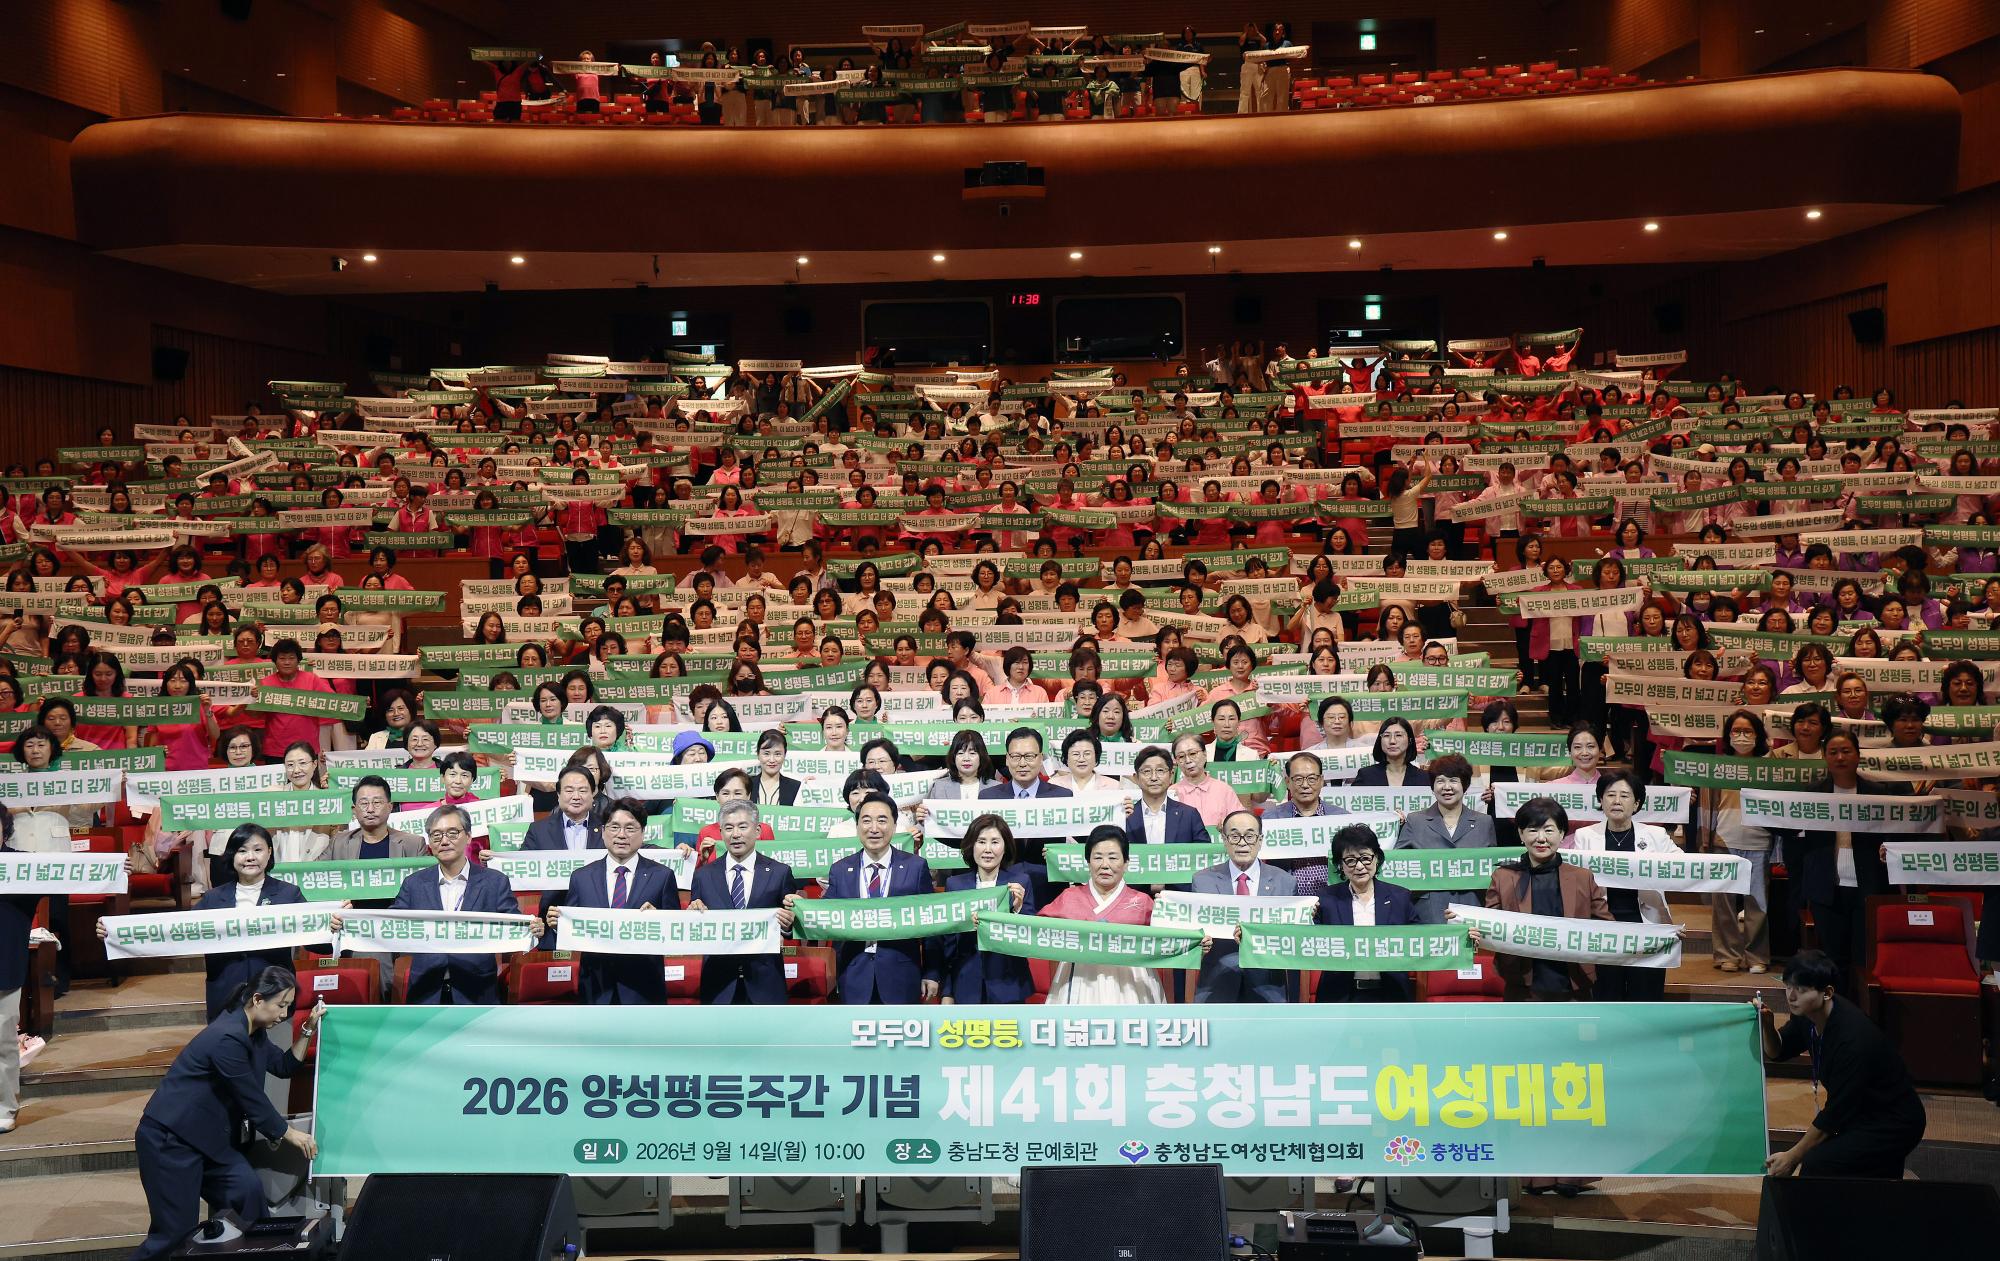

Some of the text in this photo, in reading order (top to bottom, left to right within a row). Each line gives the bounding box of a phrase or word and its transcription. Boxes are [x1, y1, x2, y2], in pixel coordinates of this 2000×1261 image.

[1011, 294, 1040, 306] 11:38
[1352, 696, 1458, 712] 성평등, 더 넓고 더 깊게
[1433, 739, 1561, 757] 모두의 성평등, 더 넓고 더
[1675, 760, 1709, 778] 모두의
[1714, 764, 1752, 782] 성평등,
[1757, 767, 1768, 781] 더
[1773, 767, 1795, 782] 넓고
[1801, 768, 1812, 782] 더
[27, 778, 111, 796] 더 넓고 더 깊게
[138, 774, 272, 795] 모두의 성평등, 더 넓고 더
[173, 798, 342, 819] 모두의 성평등, 더 넓고 더 깊게
[936, 810, 973, 826] 모두의
[1026, 809, 1037, 826] 더
[1043, 809, 1067, 826] 넓고
[1072, 808, 1084, 824] 더
[1090, 806, 1114, 823] 깊게
[1746, 799, 1937, 822] 모두의 성평등, 더 넓고 더 깊게
[17, 864, 30, 880] 더
[36, 864, 65, 880] 넓고
[70, 864, 84, 881] 더
[90, 864, 118, 881] 깊게
[1382, 859, 1492, 878] 성평등, 더 넓고 더
[1588, 853, 1738, 880] 성평등, 더 넓고 더 깊게
[804, 911, 845, 928] 모두의
[850, 909, 896, 928] 성평등,
[901, 907, 915, 926] 더
[920, 905, 946, 924] 넓고
[952, 902, 965, 921] 더
[1154, 901, 1192, 923] 모두의
[1250, 907, 1264, 924] 더
[1269, 908, 1296, 924] 넓고
[117, 926, 165, 944] 모두의
[170, 922, 222, 942] 성평등,
[226, 920, 241, 937] 더
[246, 918, 276, 936] 넓고
[282, 916, 296, 933] 더
[343, 920, 375, 938] 두의
[381, 920, 430, 941] 성평등,
[435, 921, 449, 939] 더
[455, 920, 484, 939] 넓고
[490, 920, 504, 938] 더
[572, 919, 768, 942] 모두의 성평등, 더 넓고 더 깊게
[990, 924, 1031, 944] 모두의
[1037, 928, 1084, 952] 성평등,
[1089, 933, 1102, 952] 더
[1108, 935, 1136, 954] 넓고
[1142, 937, 1155, 955] 더
[1513, 925, 1561, 949] 성평등,
[1568, 931, 1582, 951] 더
[1588, 932, 1617, 953] 넓고
[1624, 936, 1636, 954] 더
[1642, 937, 1674, 955] 깊게
[1252, 936, 1458, 959] 모두의 성평등, 더 넓고 더 깊게
[851, 1018, 1208, 1048] 모두의 성평등, 더 넓고 더 깊게
[463, 1075, 921, 1119] 2026 양성평등주간 기념
[938, 1064, 1127, 1127] 제41회
[636, 1141, 697, 1162] 2026년
[703, 1141, 731, 1162] 9월
[739, 1140, 808, 1163] 14일(월)
[814, 1142, 865, 1161] 10:00
[947, 1141, 1019, 1162] 충남도청
[1025, 1141, 1097, 1162] 문예회관
[1153, 1142, 1364, 1163] 충청남도여성단체협의회
[1430, 1142, 1495, 1163] 충청남도
[1118, 1249, 1133, 1258] JBL
